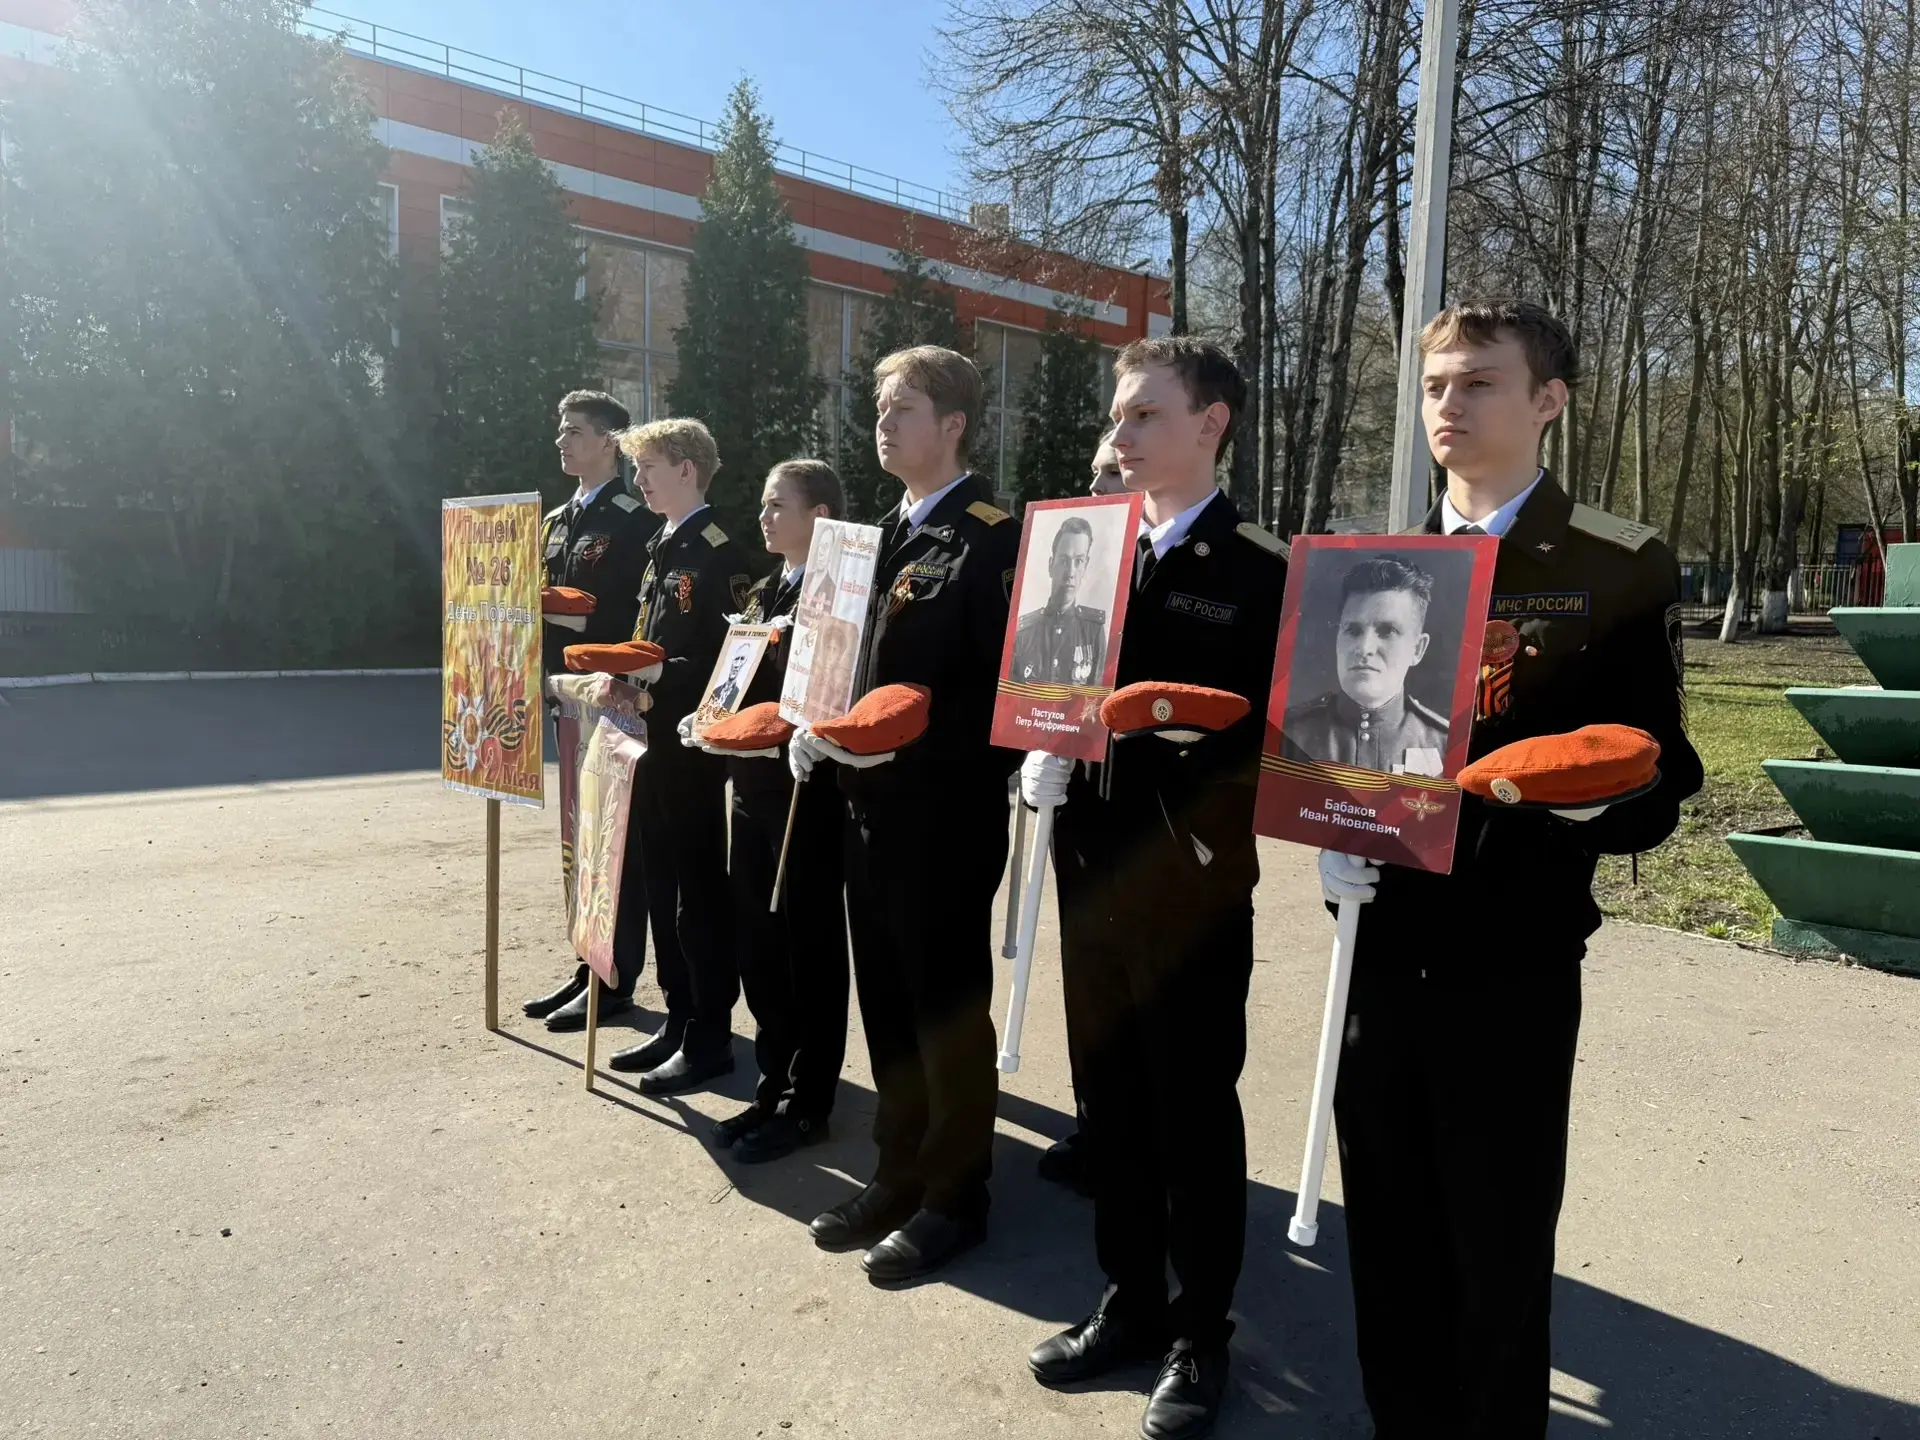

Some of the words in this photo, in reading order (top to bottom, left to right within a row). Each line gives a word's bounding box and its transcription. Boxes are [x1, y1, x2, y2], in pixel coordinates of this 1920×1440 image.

[461, 512, 517, 548] Лицей
[467, 557, 486, 586] №
[490, 556, 511, 586] 26
[447, 601, 477, 622] День
[480, 601, 536, 626] Победы
[1170, 595, 1192, 611] МЧС
[1194, 602, 1233, 621] РОССИИ
[1495, 599, 1522, 612] МЧС
[1526, 596, 1584, 611] РОССИИ
[1015, 716, 1032, 728] Петр
[1033, 718, 1080, 733] Ануфриевич
[1031, 707, 1065, 720] Пастухов
[502, 763, 540, 791] Мая
[1324, 798, 1376, 818] Бабаков
[1299, 807, 1329, 823] Иван
[1331, 813, 1401, 837] Яковлевич
